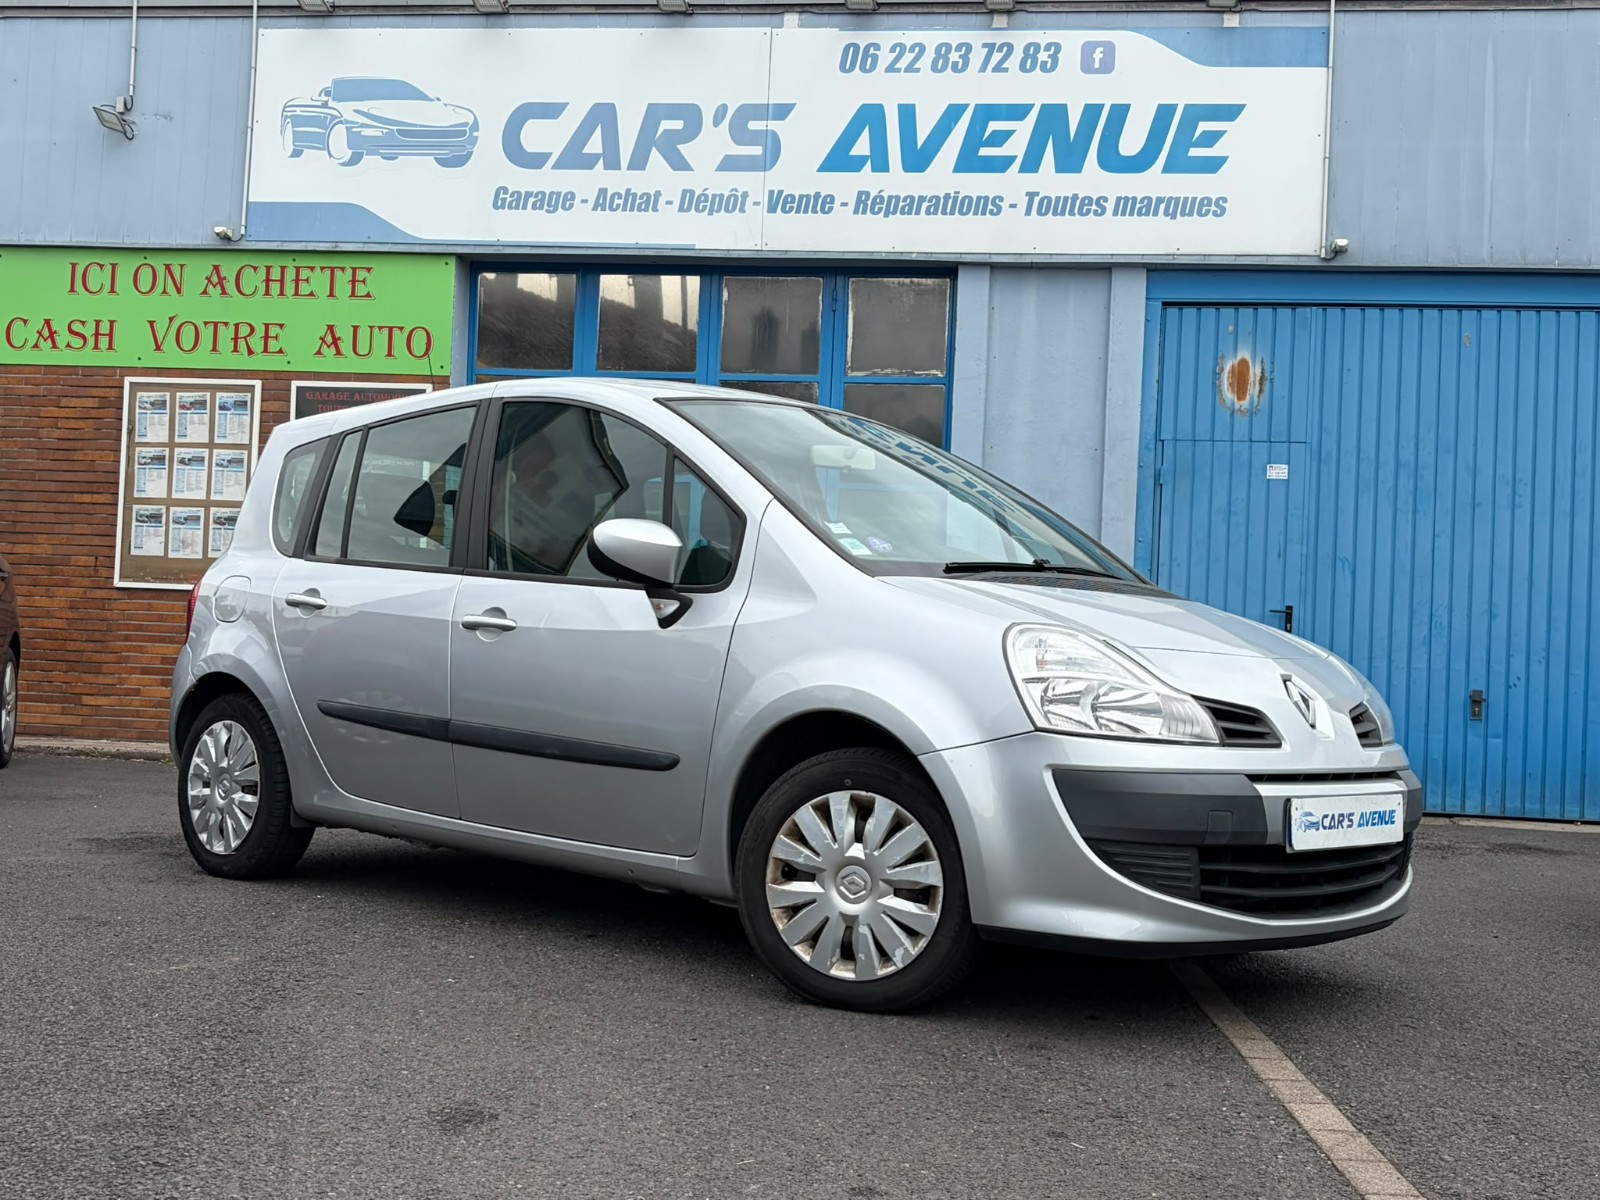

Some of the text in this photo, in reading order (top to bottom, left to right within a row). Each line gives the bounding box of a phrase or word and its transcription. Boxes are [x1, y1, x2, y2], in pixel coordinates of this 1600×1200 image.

[838, 42, 1062, 75] 06 22 83 72 83
[501, 101, 1247, 175] CAR'S AVENUE
[492, 186, 577, 214] Garage
[591, 187, 663, 213] Achat
[677, 188, 751, 216] Dépôt
[765, 189, 836, 216] Vente
[853, 189, 1005, 219] Réparations
[1022, 191, 1108, 218] Toutes
[1112, 193, 1229, 220] marques
[68, 262, 375, 301] ICI ON ACHETE
[4, 314, 436, 361] CASH VOTRE AUTO
[306, 391, 350, 401] GARAGE
[1321, 809, 1396, 831] CAR'S AVENUE
